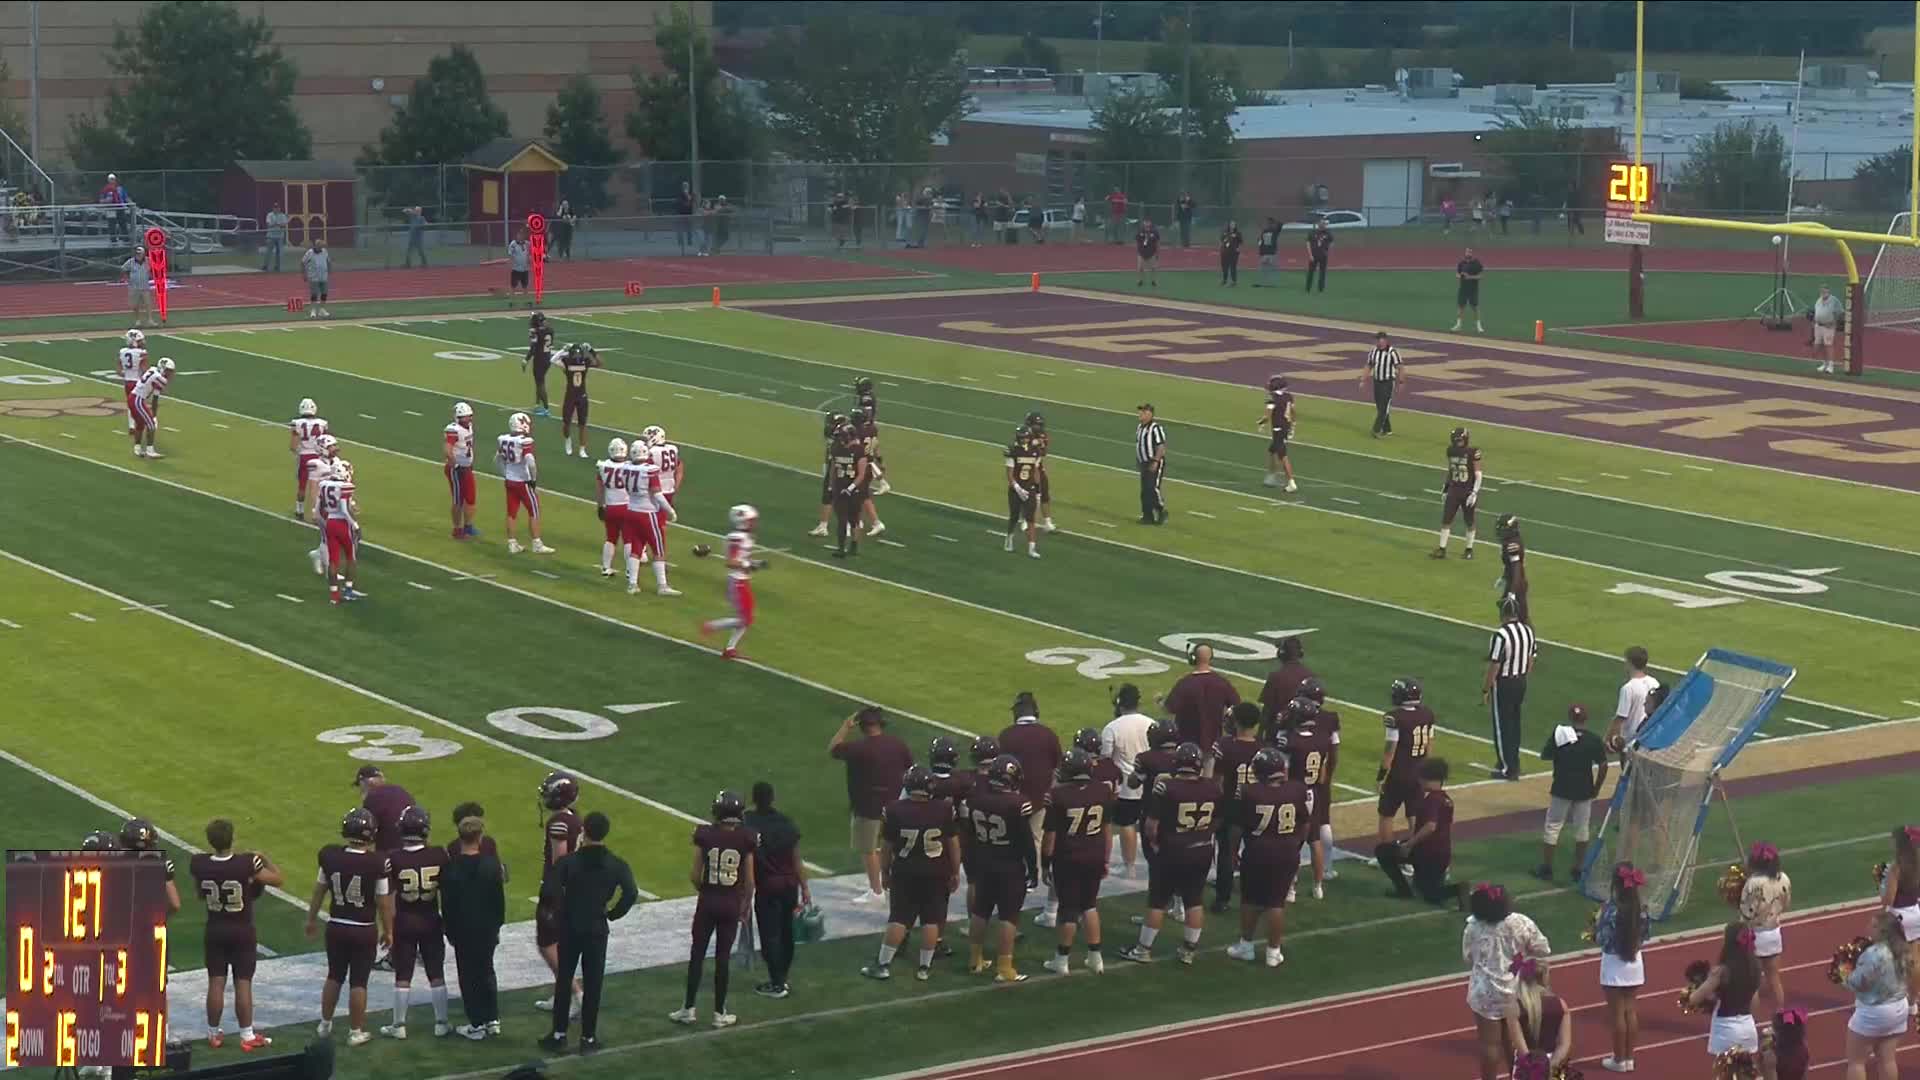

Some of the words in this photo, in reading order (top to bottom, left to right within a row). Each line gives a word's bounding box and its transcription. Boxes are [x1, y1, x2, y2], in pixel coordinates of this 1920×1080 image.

[124, 353, 133, 369] 3
[300, 422, 322, 441] 14
[604, 467, 624, 490] 76
[623, 470, 640, 493] 77
[320, 485, 337, 509] 15
[1066, 804, 1103, 836] 72
[1176, 801, 1216, 833] 52
[1251, 803, 1296, 837] 78
[898, 827, 944, 859] 76
[707, 847, 742, 886] 18
[330, 871, 366, 908] 14
[399, 866, 441, 902] 35
